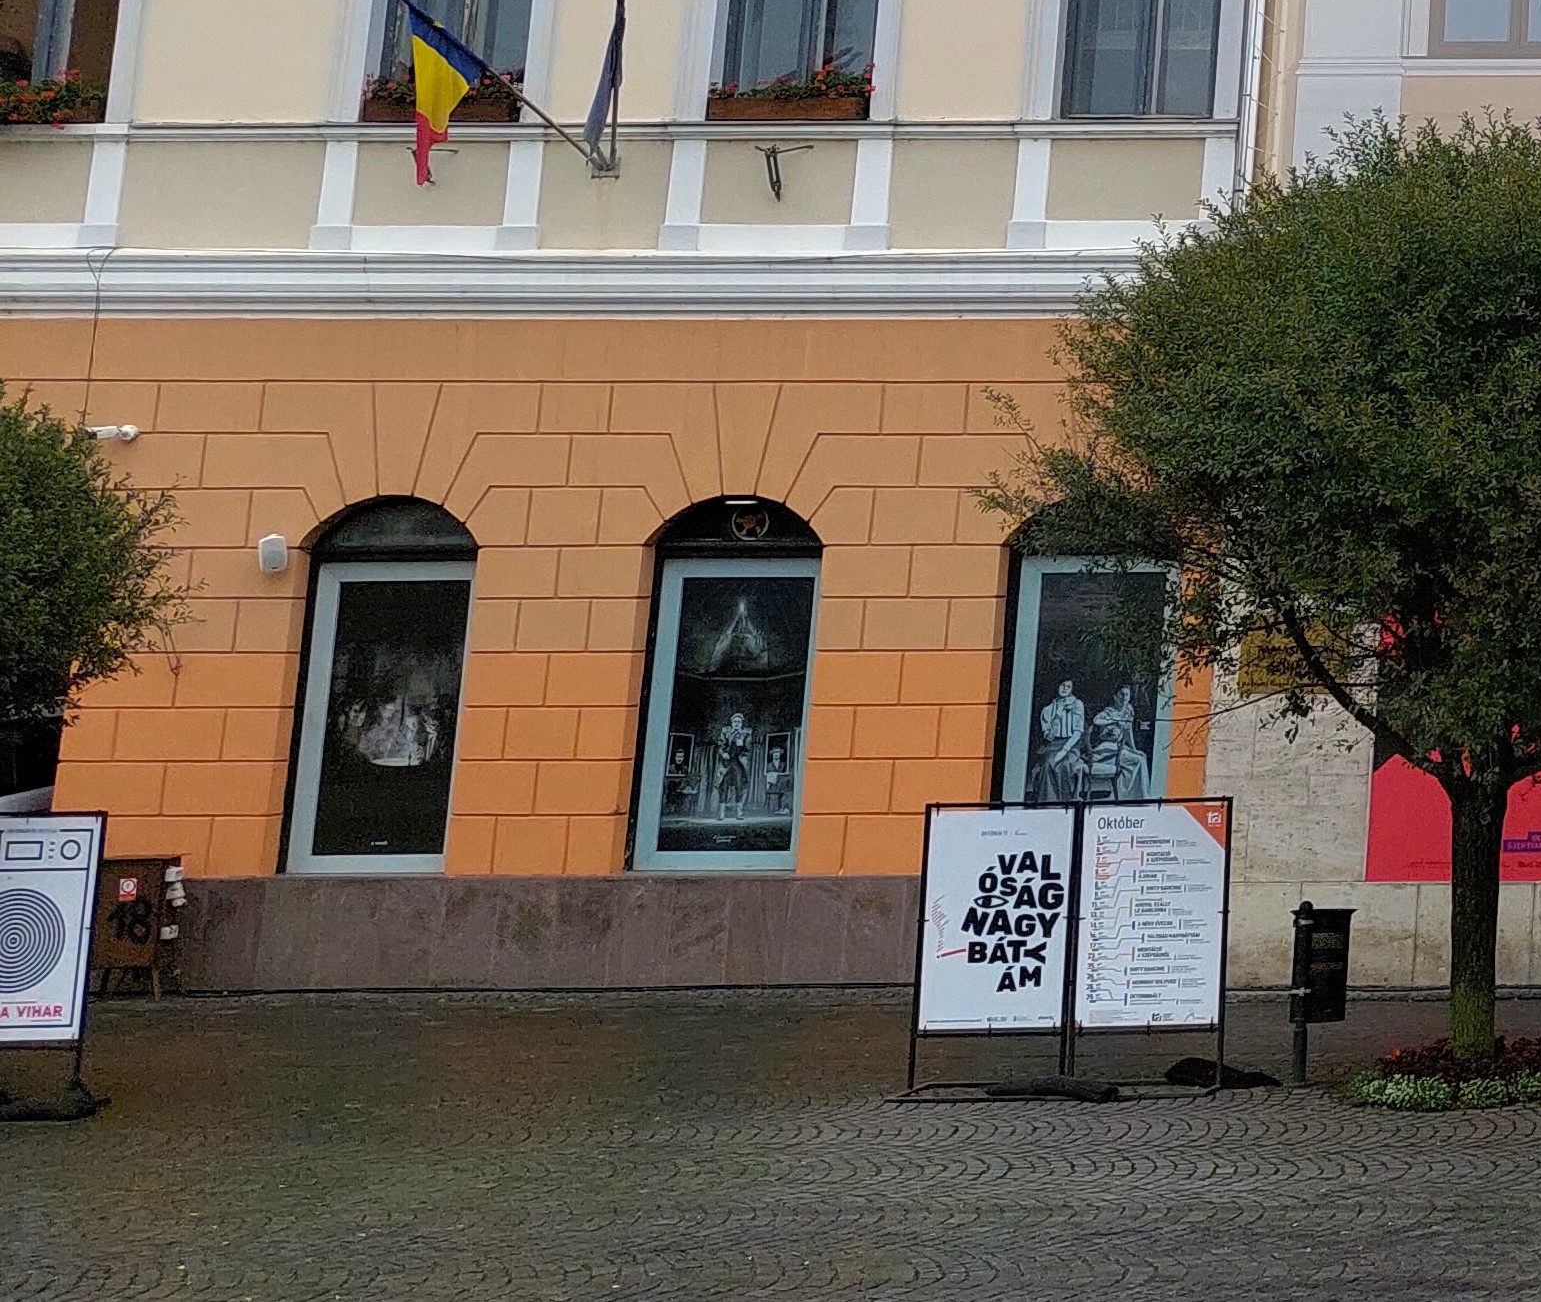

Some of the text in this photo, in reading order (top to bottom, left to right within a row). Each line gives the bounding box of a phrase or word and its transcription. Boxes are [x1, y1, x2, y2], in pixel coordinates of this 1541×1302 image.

[1097, 816, 1145, 830] Október
[997, 851, 1061, 880] VAL
[978, 866, 1065, 910] ÓSÁG
[960, 906, 1061, 938] NAGY
[996, 965, 1042, 992] ÁM
[16, 1005, 63, 1018] VIHAR
